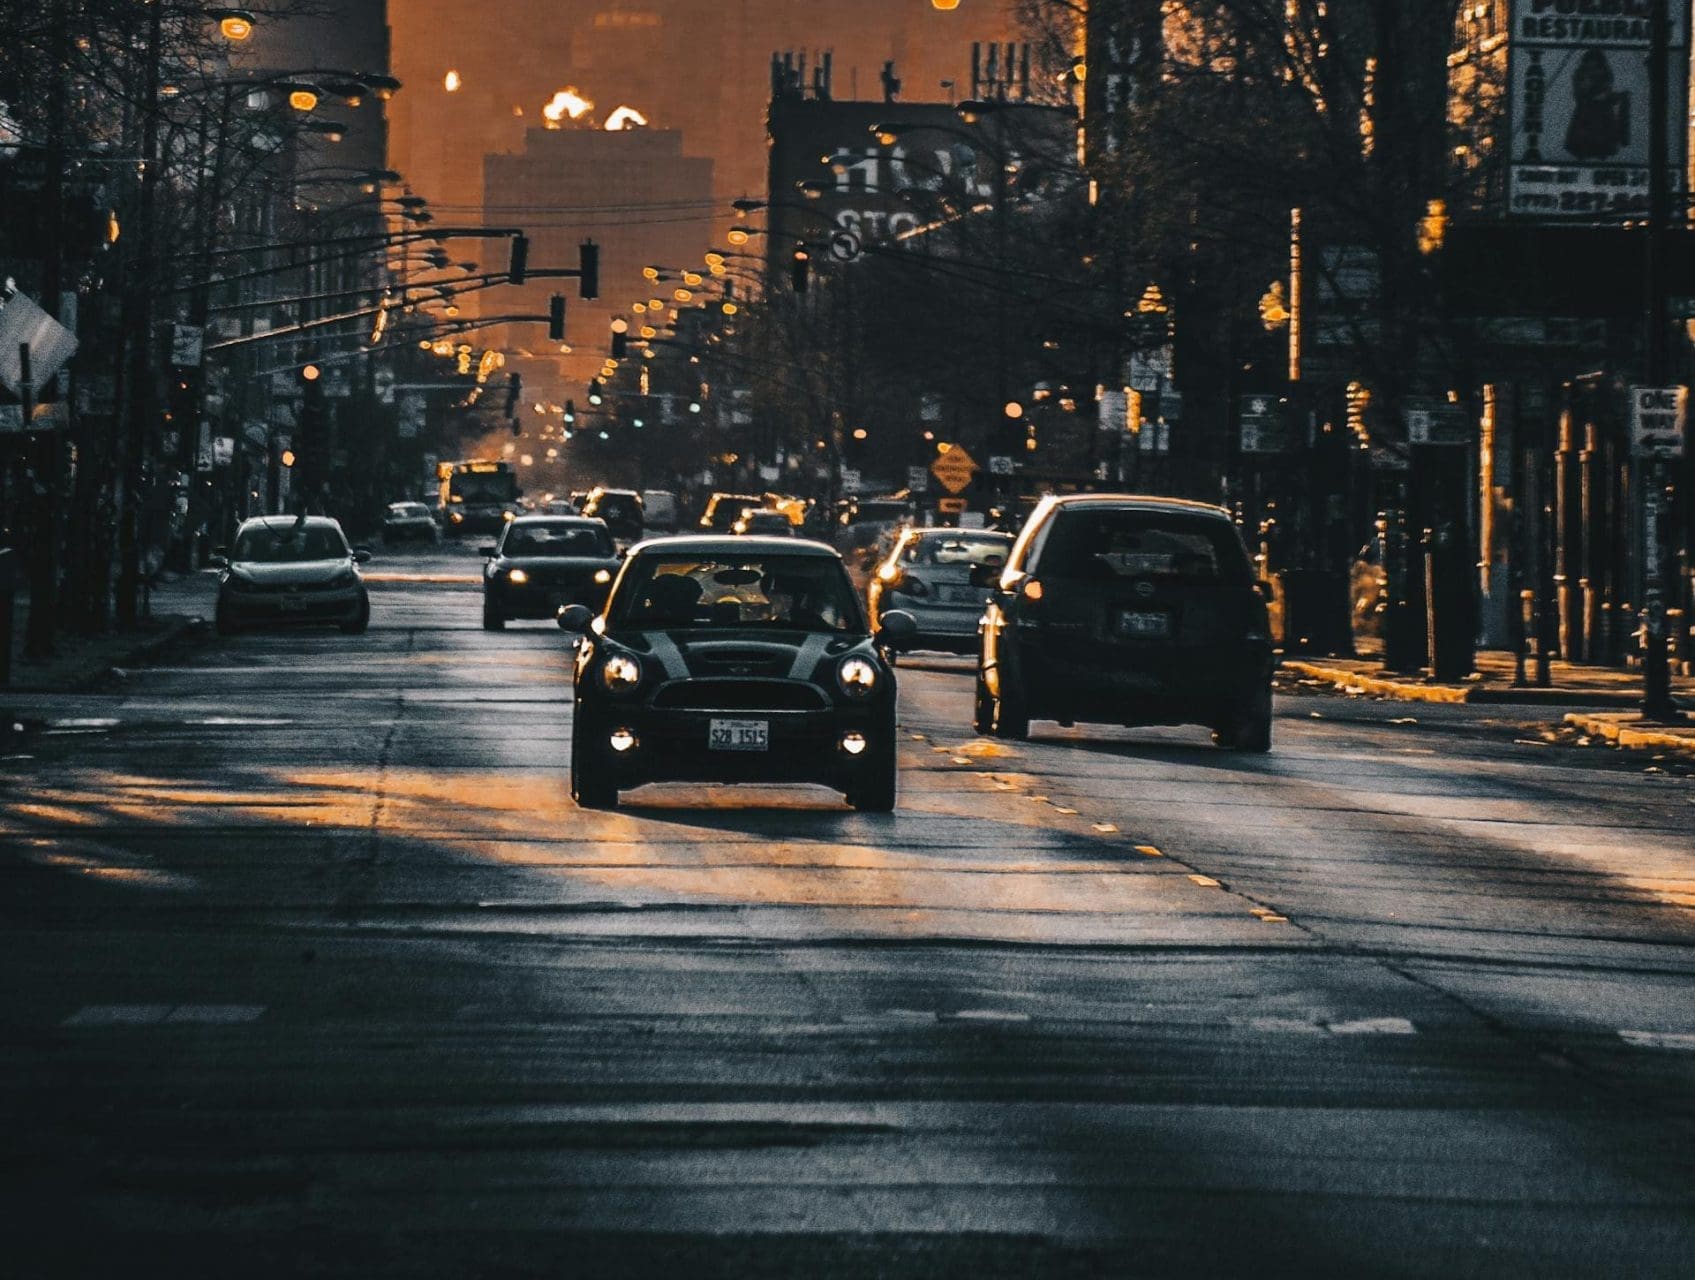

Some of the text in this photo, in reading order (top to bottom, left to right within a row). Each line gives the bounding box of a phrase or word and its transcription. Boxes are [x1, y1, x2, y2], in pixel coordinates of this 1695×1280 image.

[1522, 17, 1675, 39] RESTAURAT
[1640, 391, 1678, 410] ONE
[1640, 413, 1679, 430] WAY
[739, 729, 766, 745] 1515
